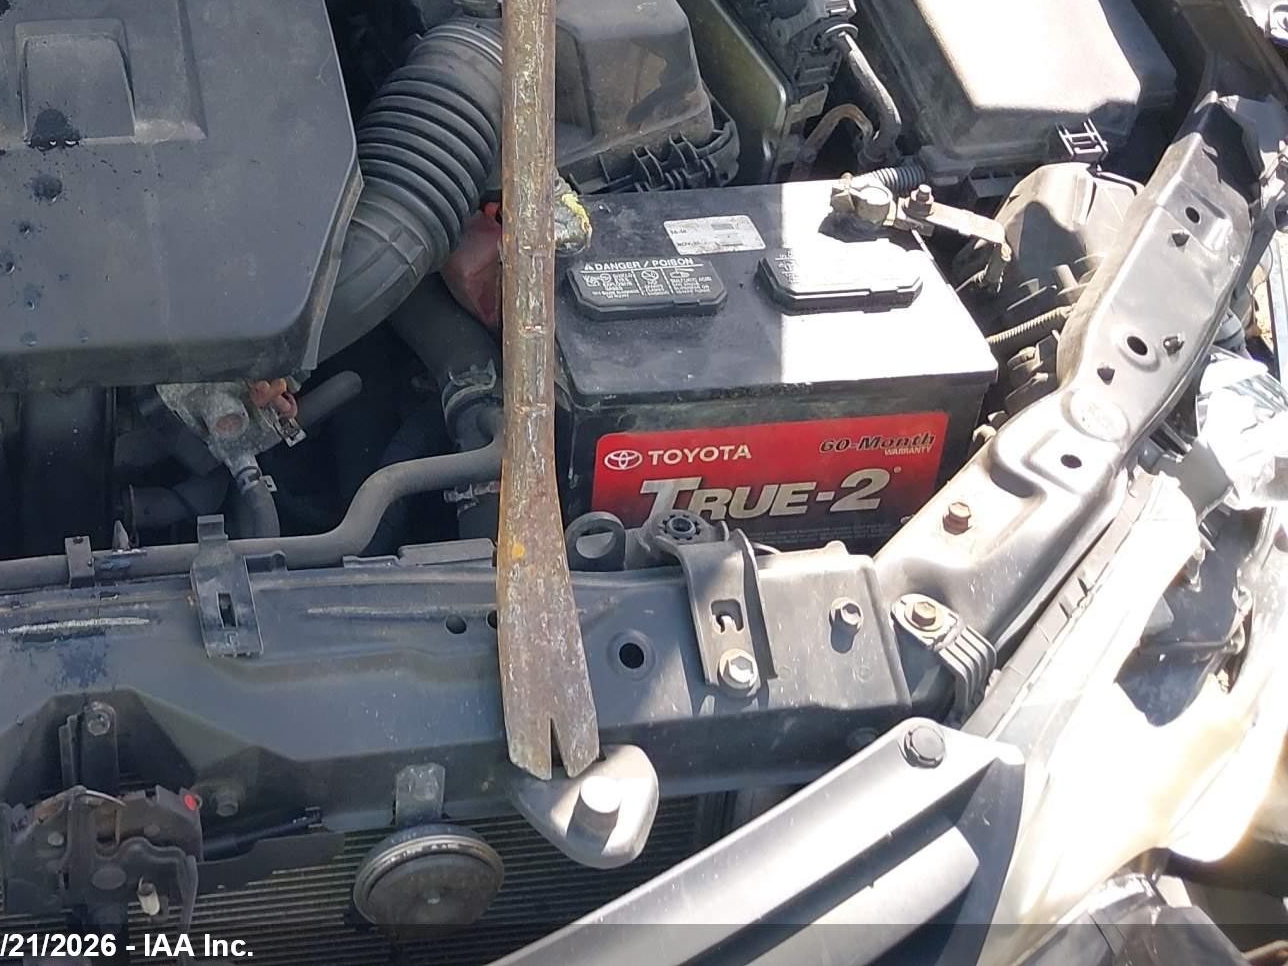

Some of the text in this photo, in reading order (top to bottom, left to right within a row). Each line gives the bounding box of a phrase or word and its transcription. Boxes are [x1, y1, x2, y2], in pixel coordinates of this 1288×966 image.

[594, 260, 641, 271] DANGER
[819, 432, 936, 453] 60-Month
[884, 445, 932, 456] WARRANTY
[647, 445, 752, 467] TOYOTA
